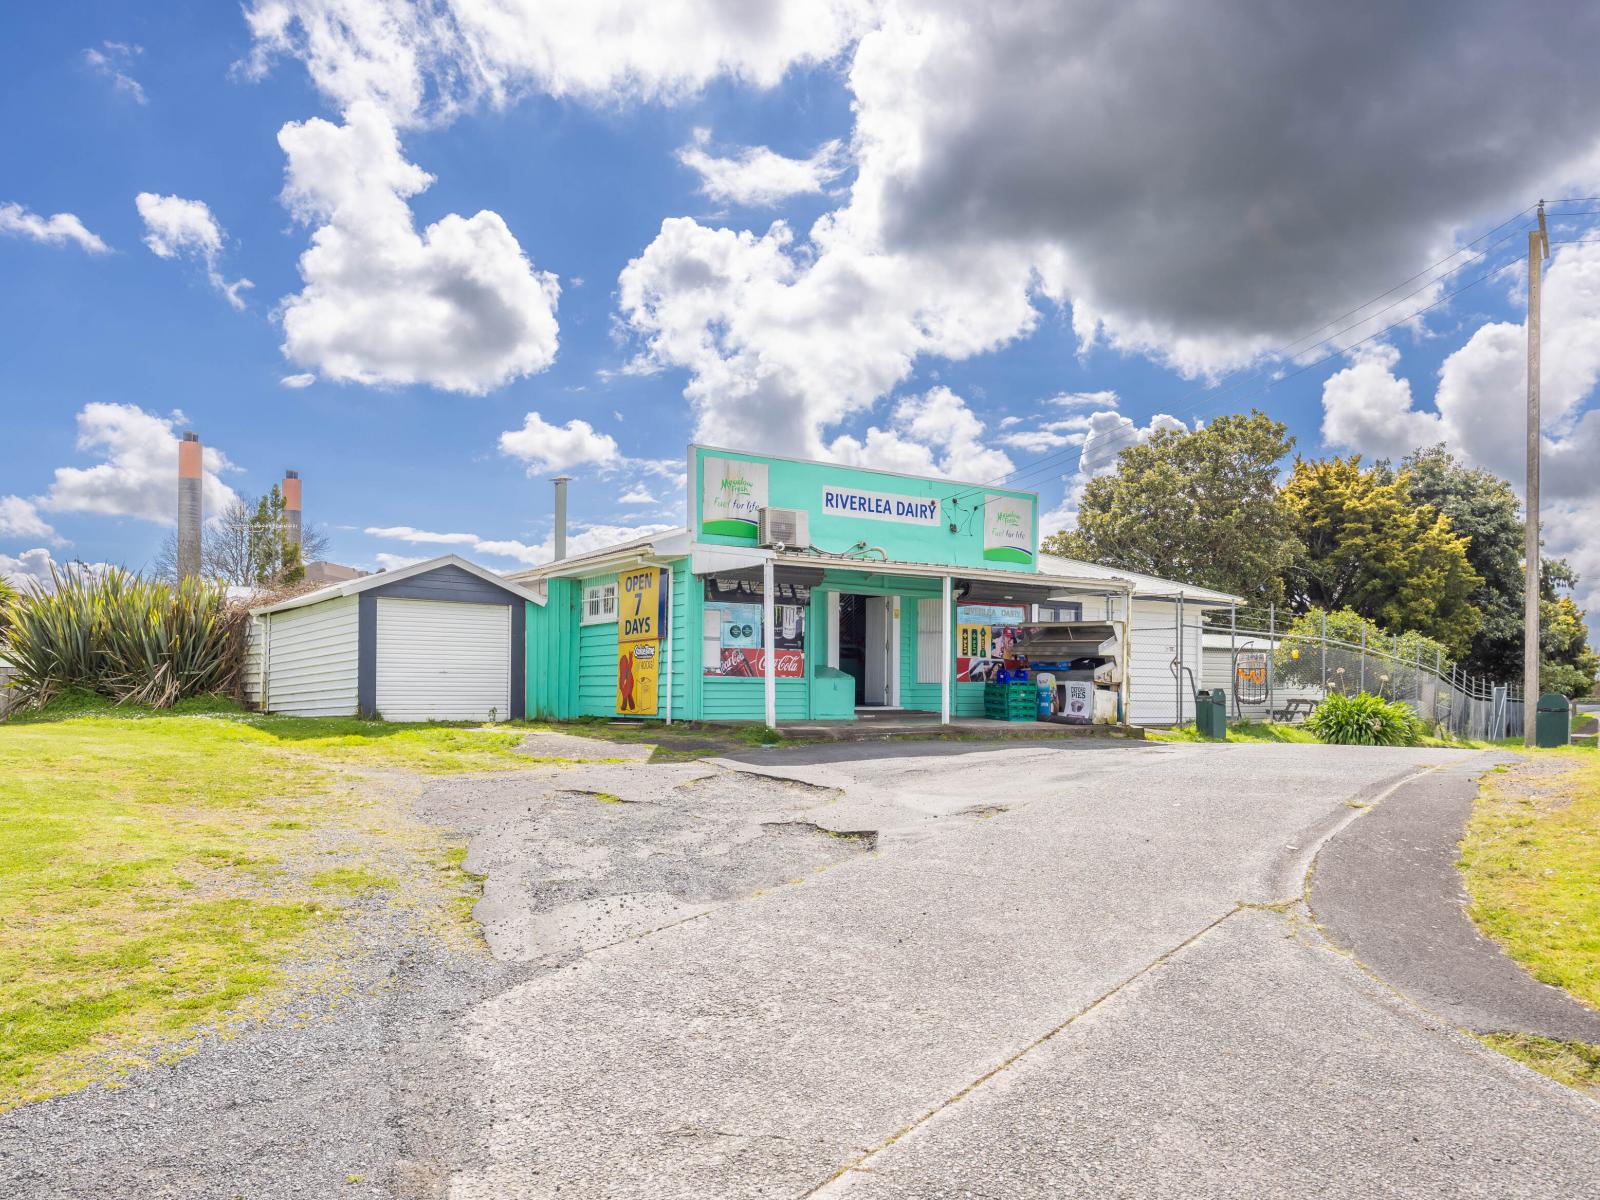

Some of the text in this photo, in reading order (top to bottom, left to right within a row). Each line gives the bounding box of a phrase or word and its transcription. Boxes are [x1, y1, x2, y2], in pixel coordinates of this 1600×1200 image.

[714, 496, 760, 512] Fuel for life
[825, 492, 937, 519] RIVERLEA DAIRY
[625, 572, 653, 592] OPEN
[635, 593, 642, 616] 7
[625, 617, 651, 635] DAYS
[759, 655, 800, 671] C-Cola
[1071, 691, 1086, 699] PIES
